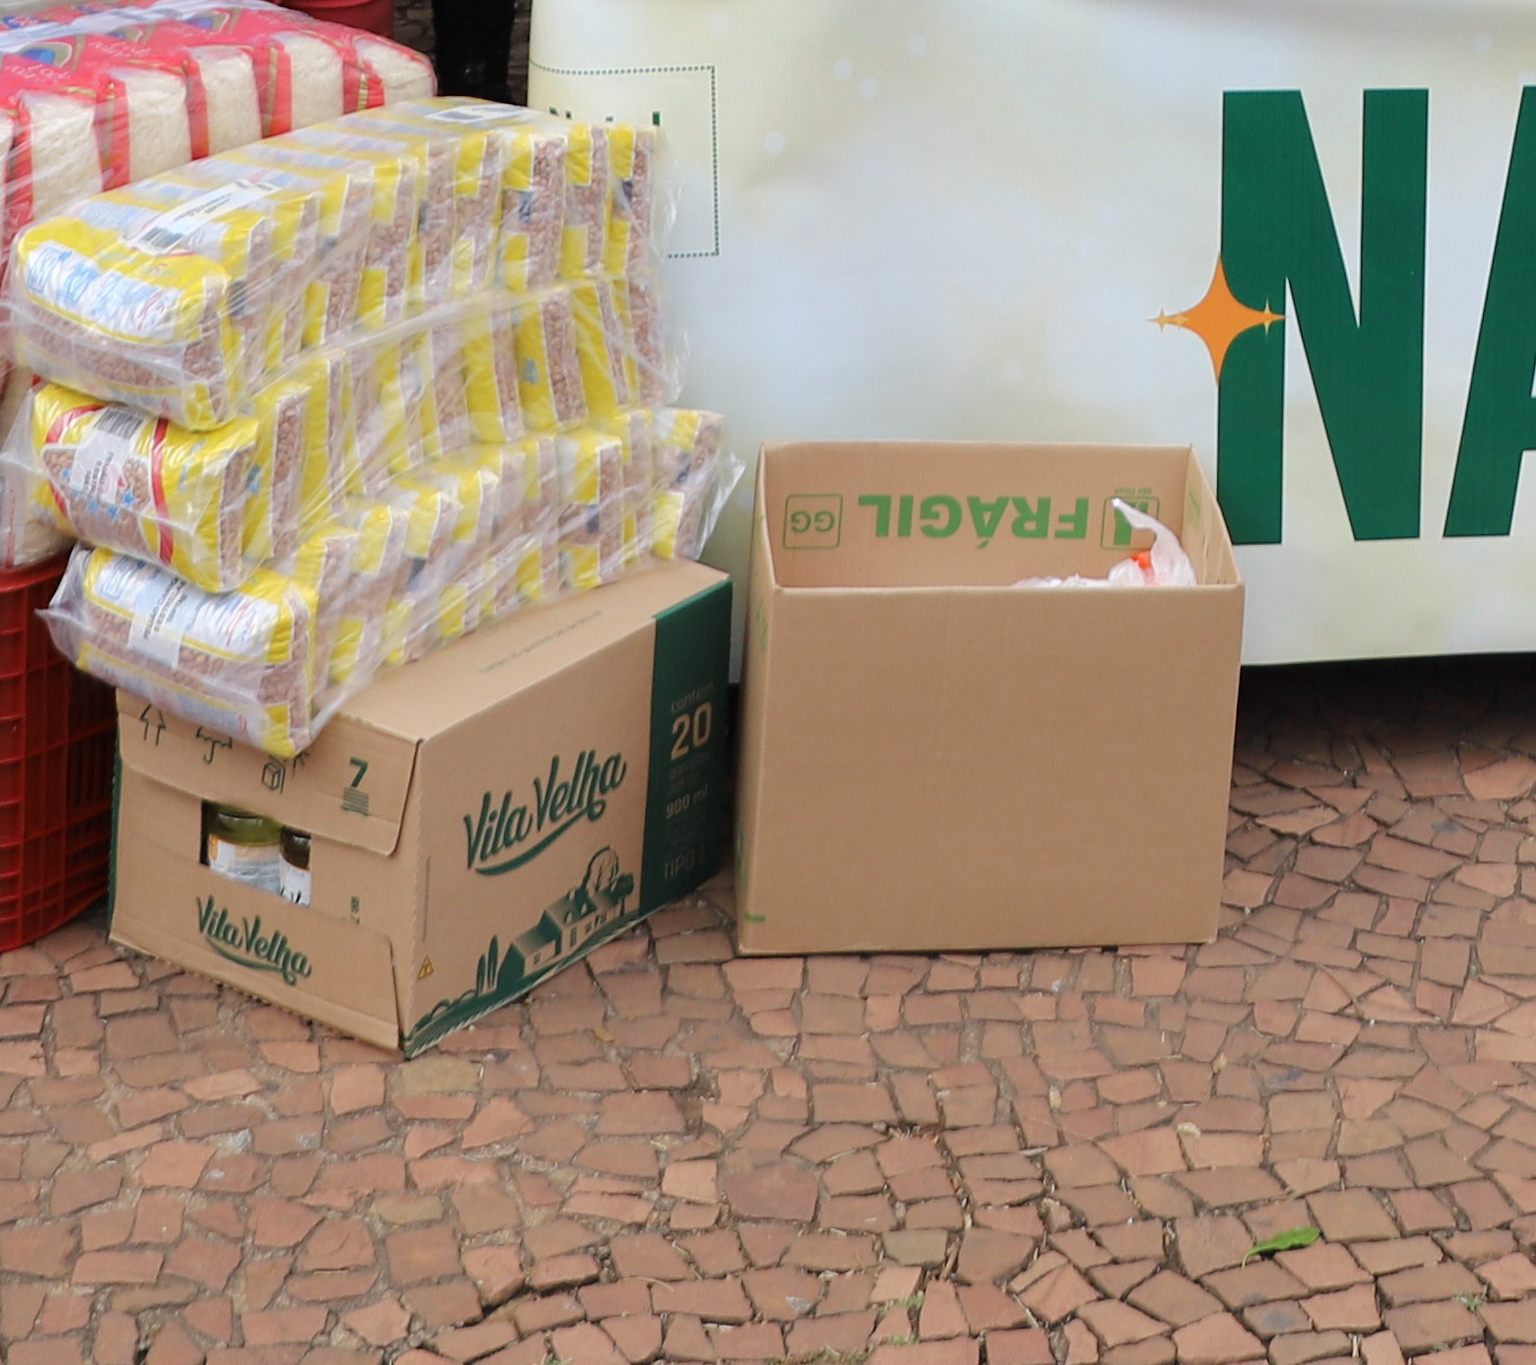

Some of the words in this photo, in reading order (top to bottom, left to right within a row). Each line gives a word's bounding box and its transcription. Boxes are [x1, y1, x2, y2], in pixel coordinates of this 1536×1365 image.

[790, 510, 835, 532] GG
[858, 494, 1090, 550] FRÁGIL
[670, 701, 713, 762] 20
[348, 756, 369, 788] 7
[463, 790, 532, 870] Vila
[533, 748, 628, 832] Velha
[666, 793, 691, 819] 900
[195, 894, 243, 950] Vila
[242, 914, 313, 986] Velha
